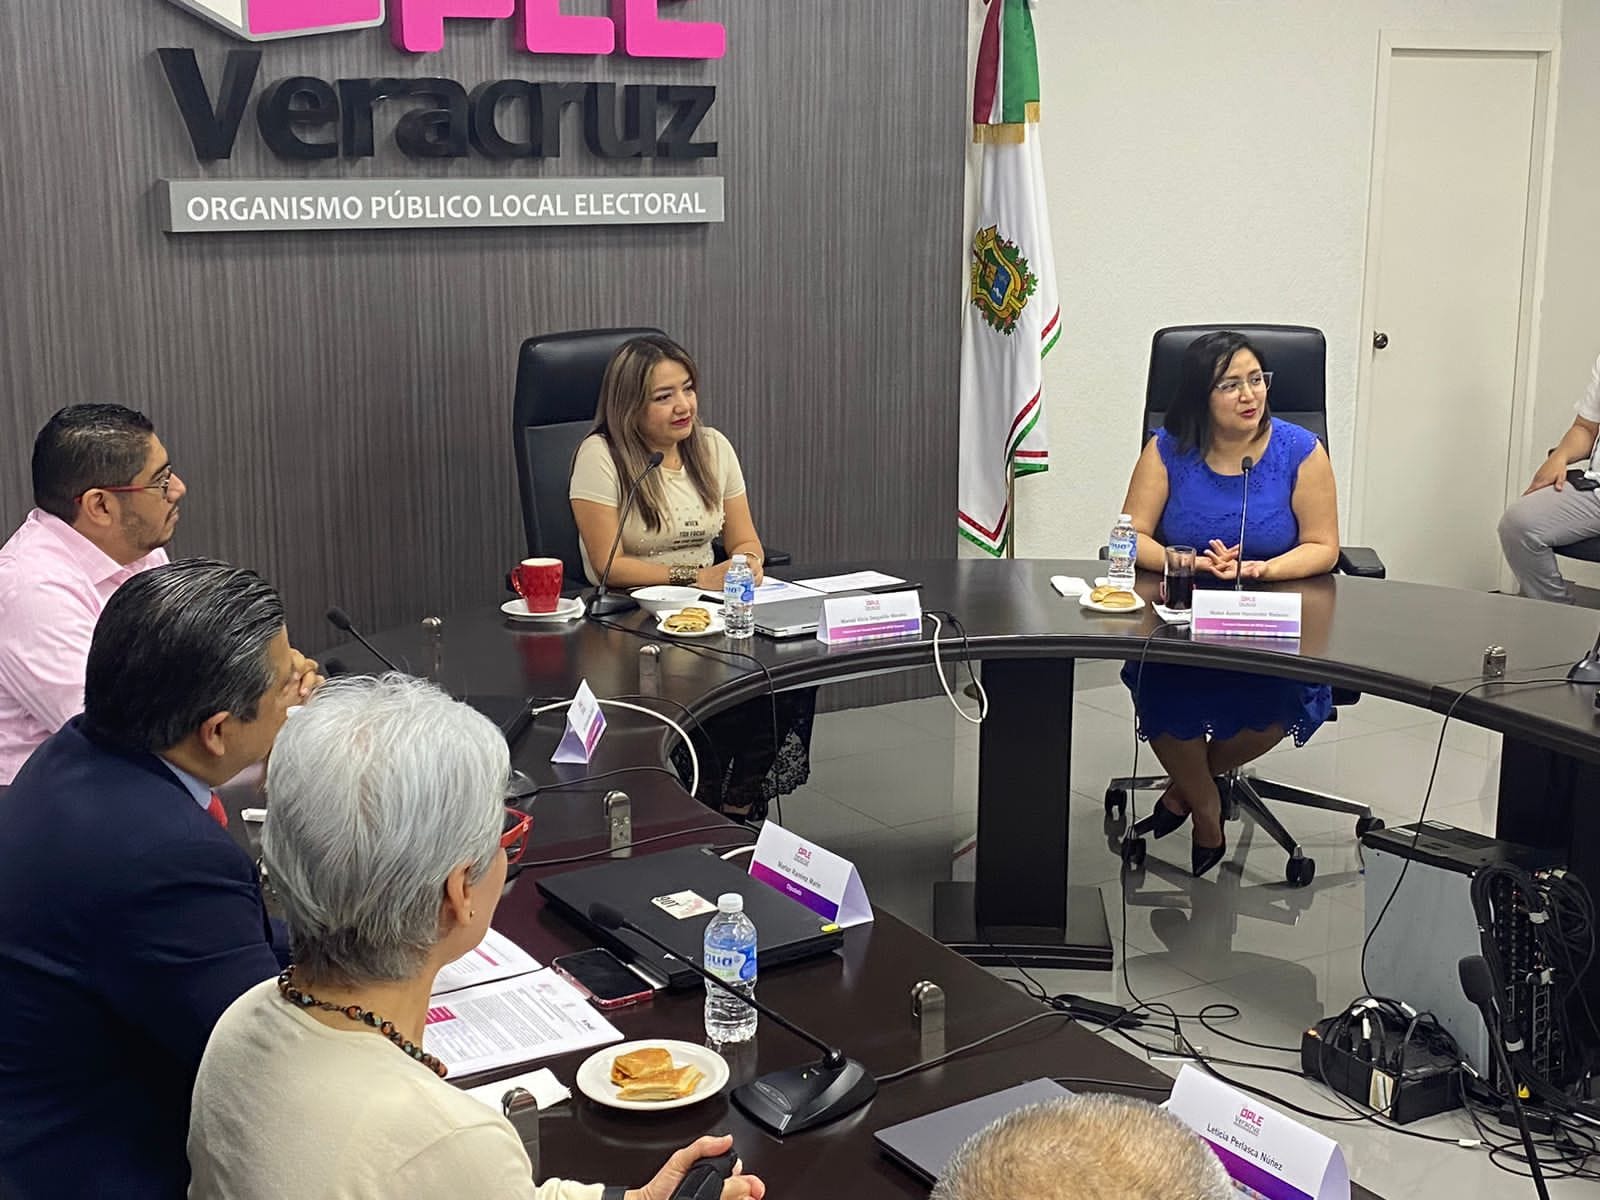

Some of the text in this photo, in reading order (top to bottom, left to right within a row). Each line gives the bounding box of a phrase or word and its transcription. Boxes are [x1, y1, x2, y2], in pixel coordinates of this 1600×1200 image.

[157, 47, 719, 160] Veracruz
[187, 190, 706, 221] ORGANISMO PÚBLICO LOCAL ELECTORAL
[1240, 1108, 1264, 1127] OPLE
[1207, 1122, 1229, 1141] Leticia
[1230, 1136, 1259, 1159] Perlasca
